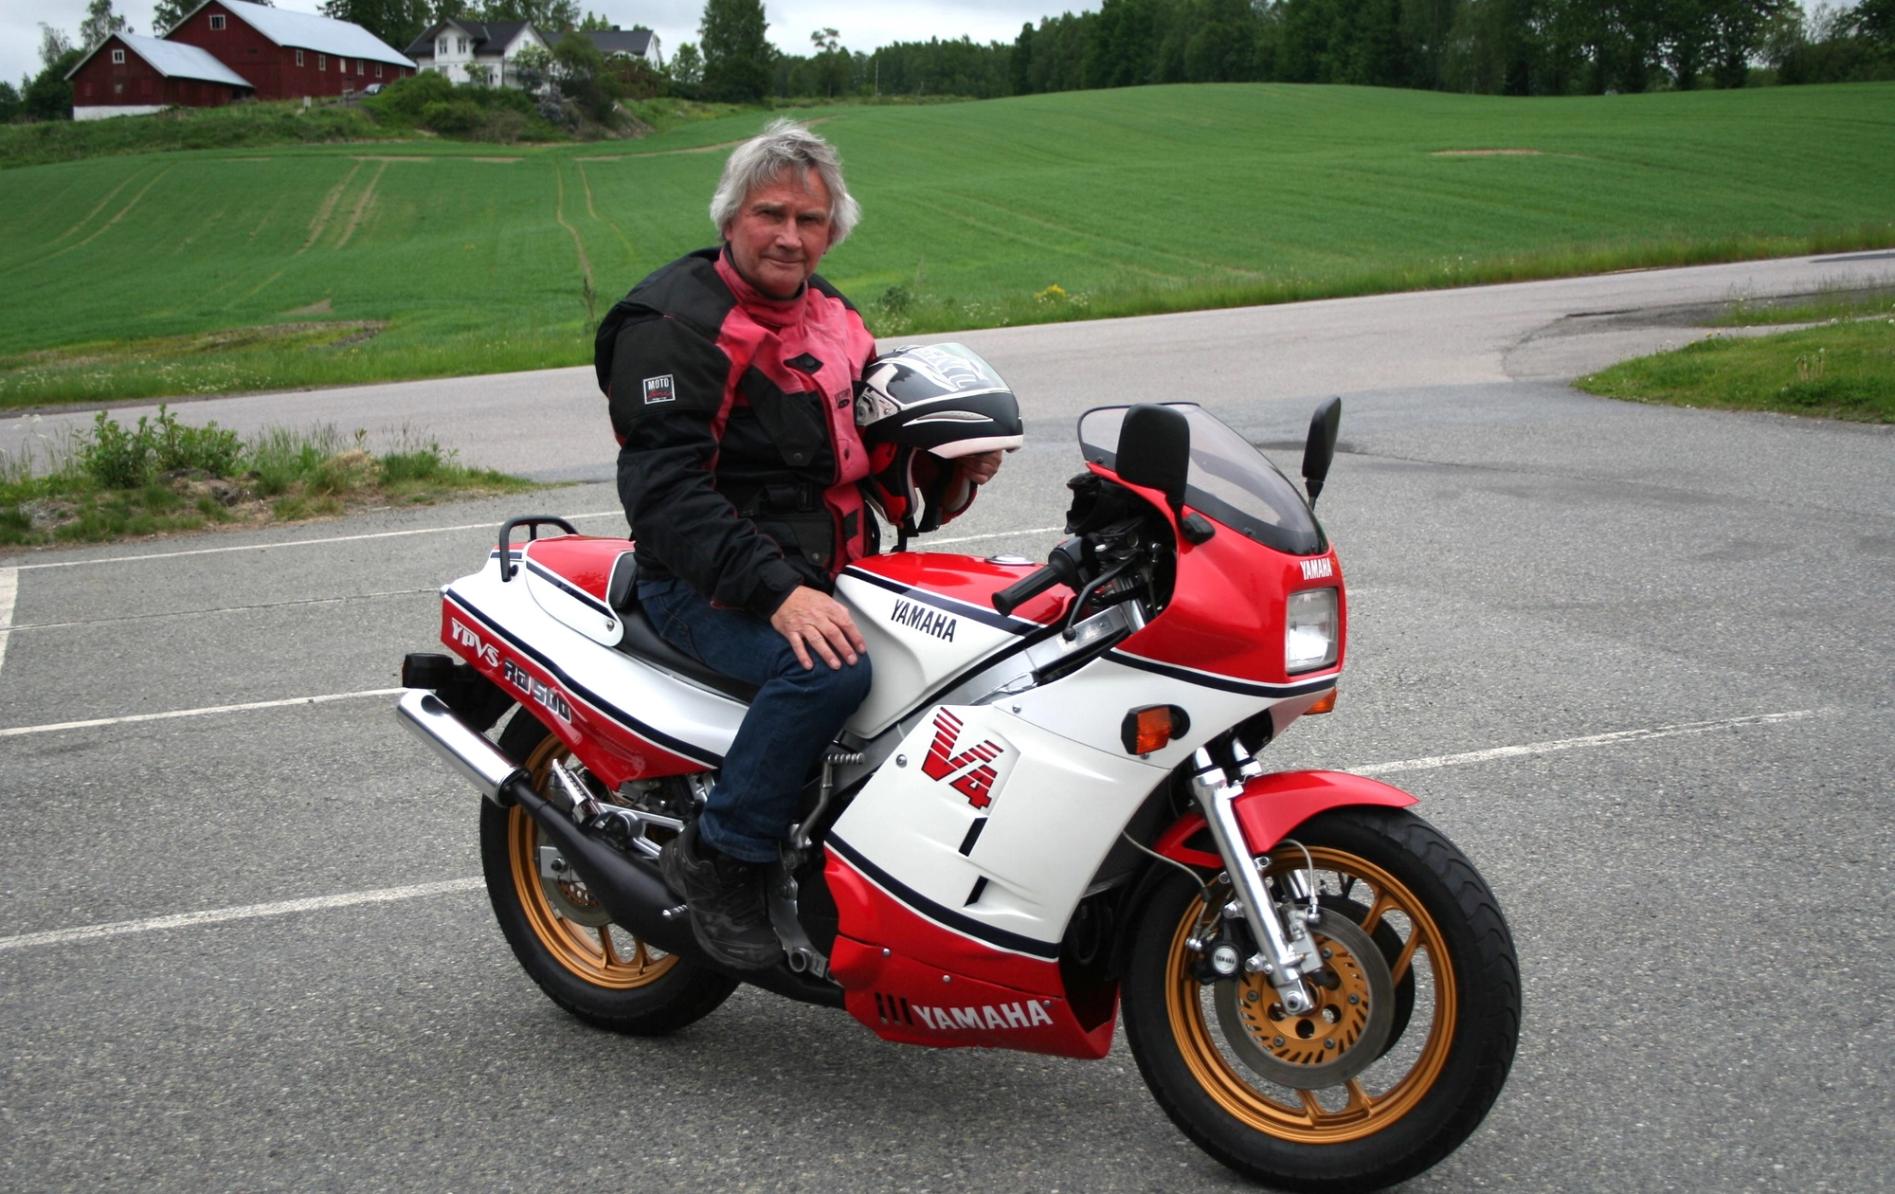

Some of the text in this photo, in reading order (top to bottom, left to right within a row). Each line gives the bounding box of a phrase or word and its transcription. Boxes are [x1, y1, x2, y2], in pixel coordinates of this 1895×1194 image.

[648, 377, 670, 391] MOTO
[1300, 557, 1333, 581] YAMAHA
[890, 599, 957, 643] YAMAHA
[451, 617, 499, 668] YPVS
[921, 706, 1004, 810] V4
[911, 999, 1053, 1030] YAMAHA
